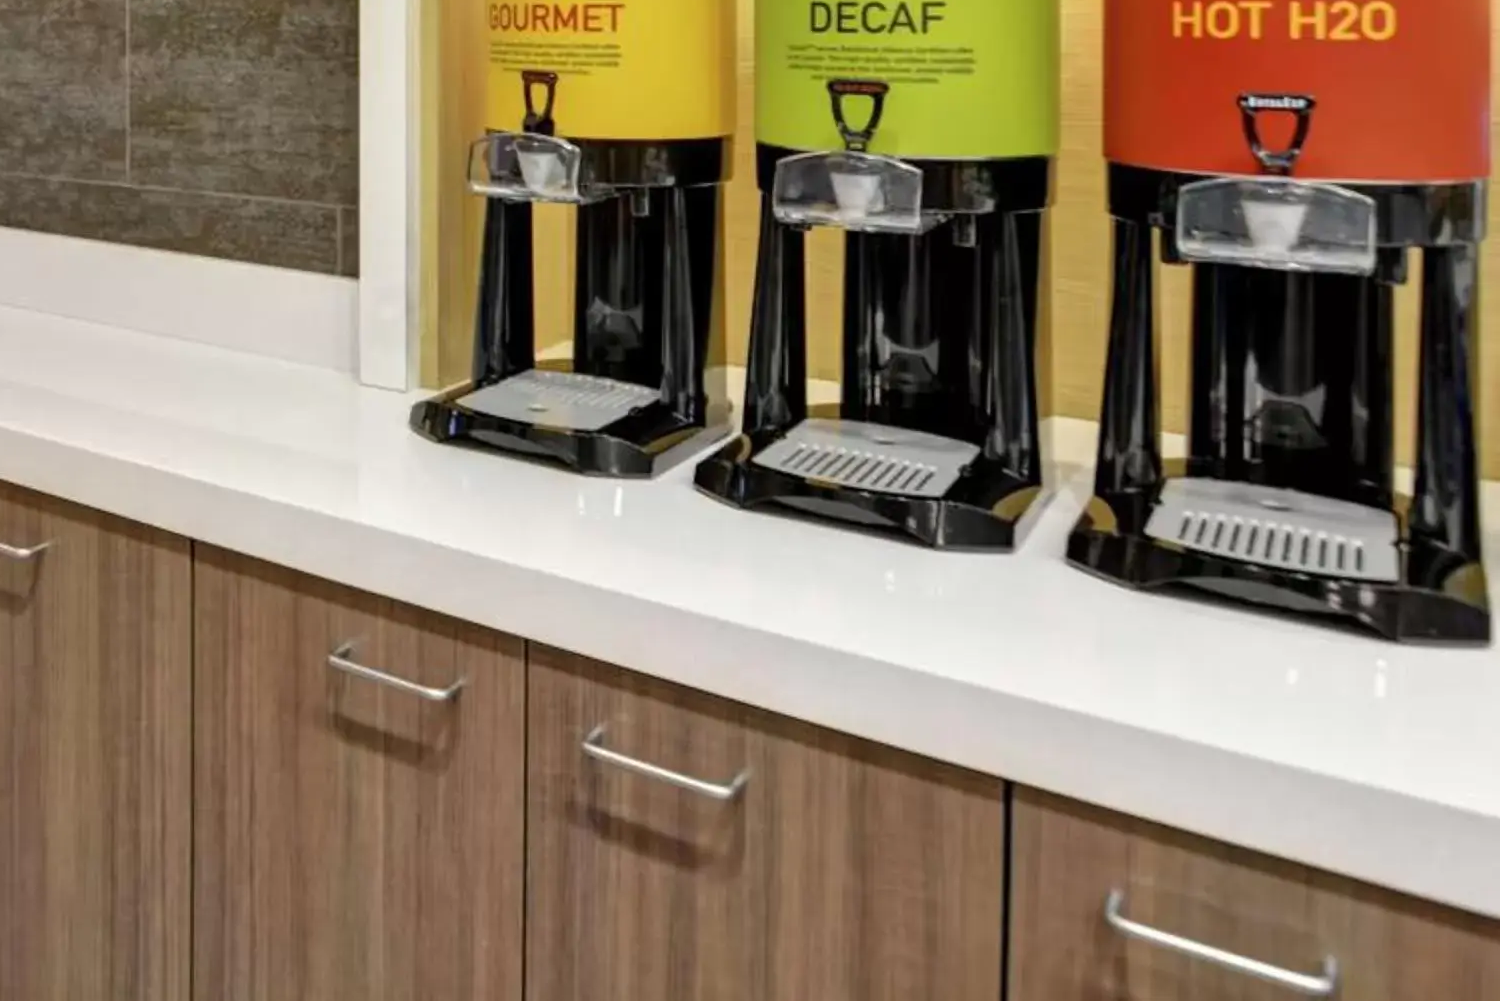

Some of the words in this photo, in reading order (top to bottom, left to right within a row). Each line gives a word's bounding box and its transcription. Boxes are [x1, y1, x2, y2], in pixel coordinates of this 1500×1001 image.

[489, 3, 626, 32] GOURMET
[810, 1, 947, 34] DECAF
[1172, 0, 1274, 39] HOT
